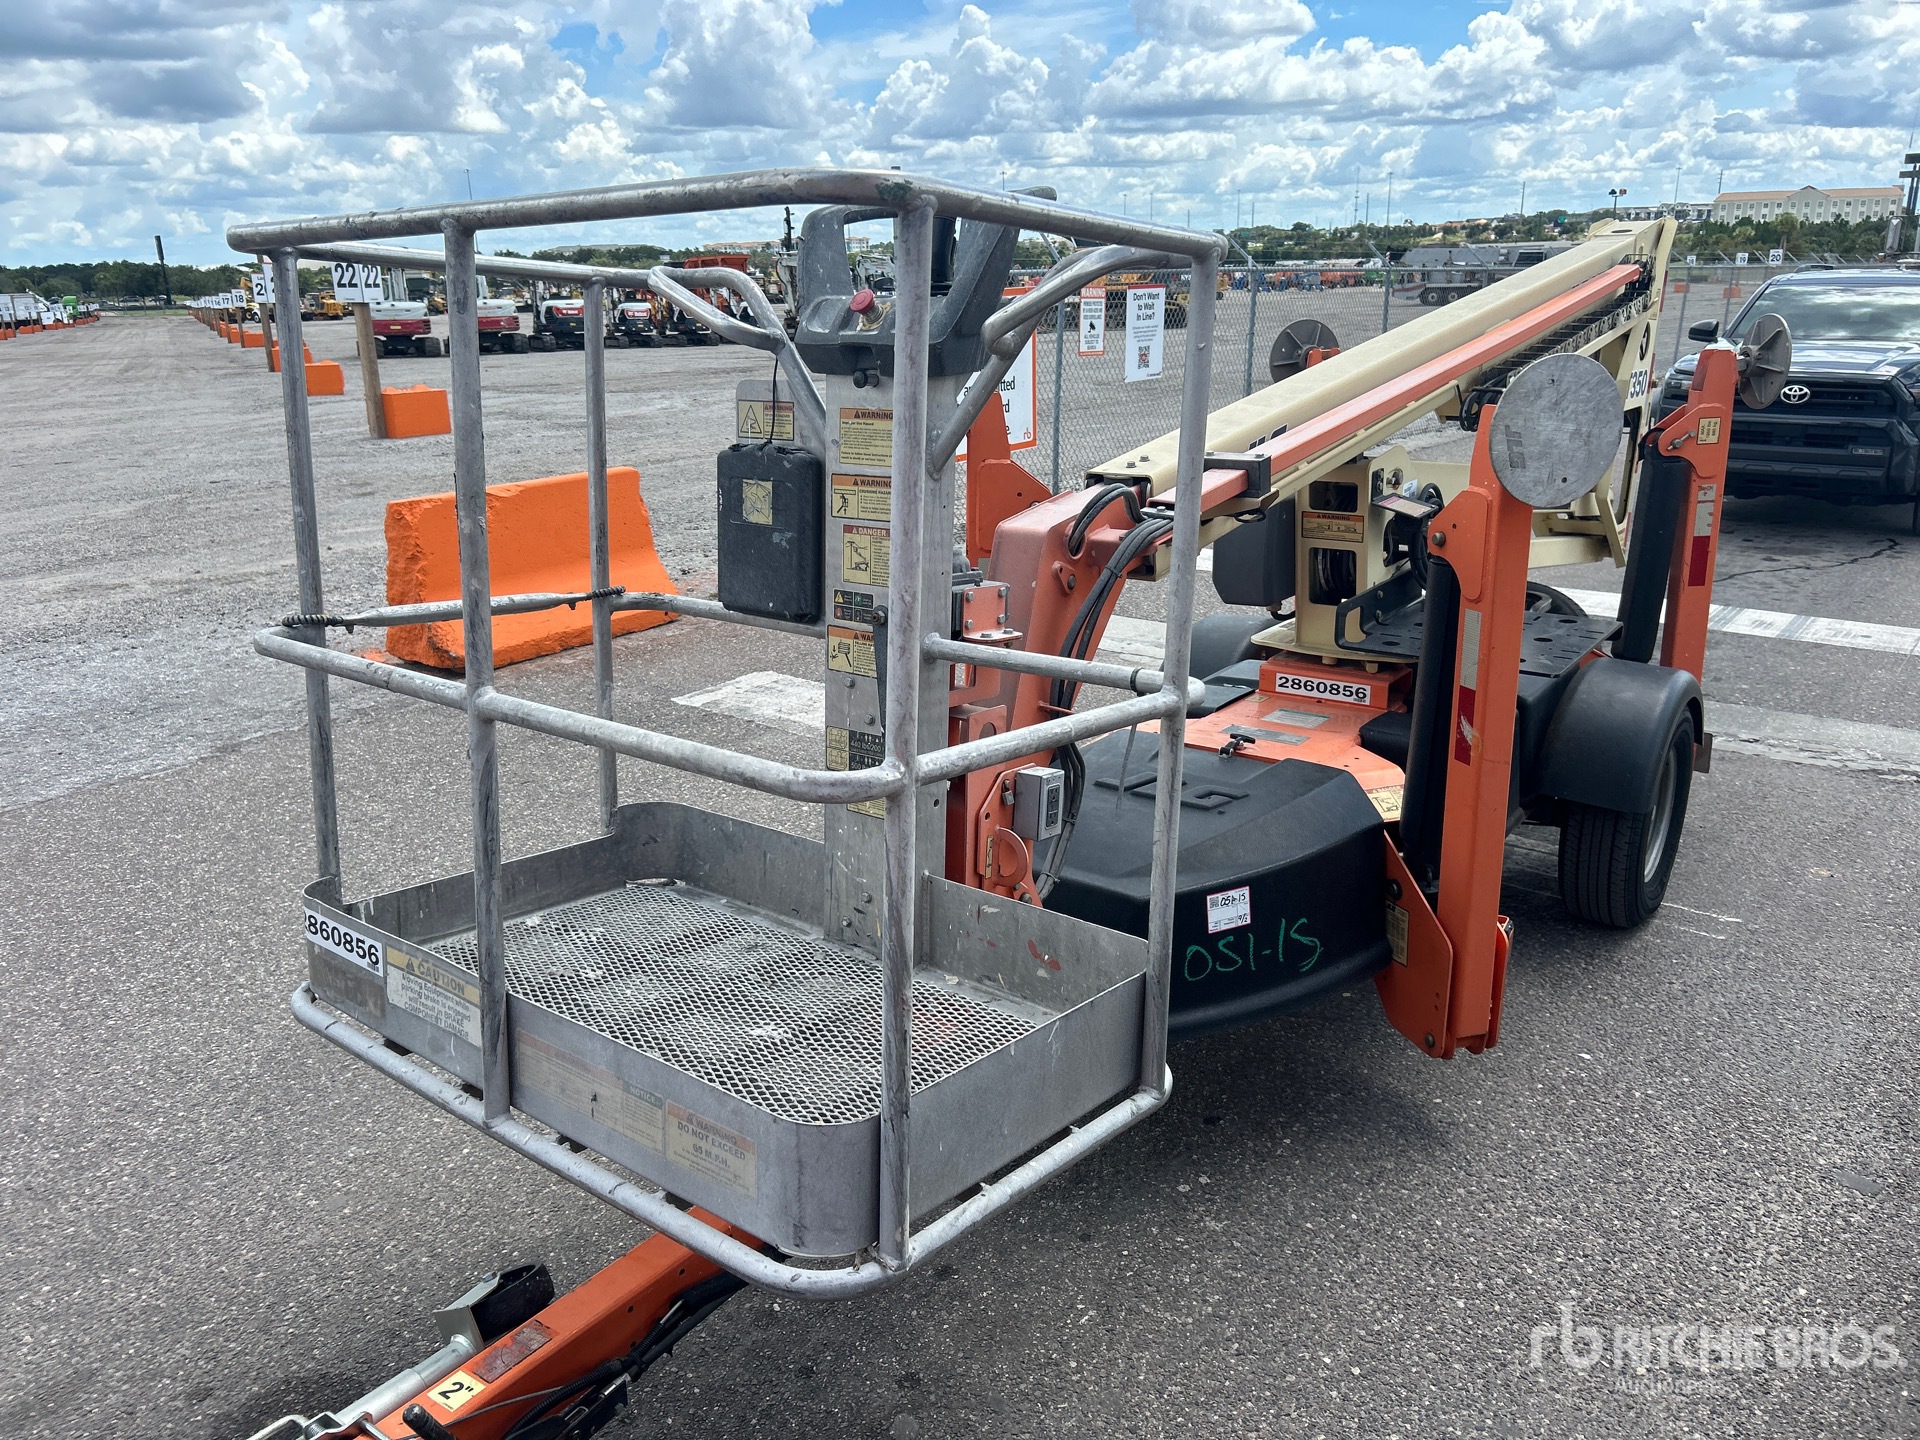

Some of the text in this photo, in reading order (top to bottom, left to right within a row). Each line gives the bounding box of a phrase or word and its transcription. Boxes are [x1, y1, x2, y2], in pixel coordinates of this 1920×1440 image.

[1770, 254, 1781, 262] 20
[335, 262, 358, 288] 22
[362, 264, 381, 288] 22
[255, 283, 266, 296] 2
[1081, 287, 1106, 298] WARNING
[221, 297, 230, 305] 17
[234, 294, 244, 303] 18
[1133, 292, 1160, 301] Don't Want
[1137, 302, 1155, 311] to Wait
[1136, 312, 1155, 321] In Line?
[1629, 369, 1648, 399] 350
[860, 411, 894, 419] WARNING
[858, 528, 887, 536] DANGER
[1277, 676, 1368, 700] 2860856
[417, 960, 465, 996] CAUTION
[677, 1121, 746, 1160] DO NOT EXCEED
[437, 1381, 474, 1401] 2"
